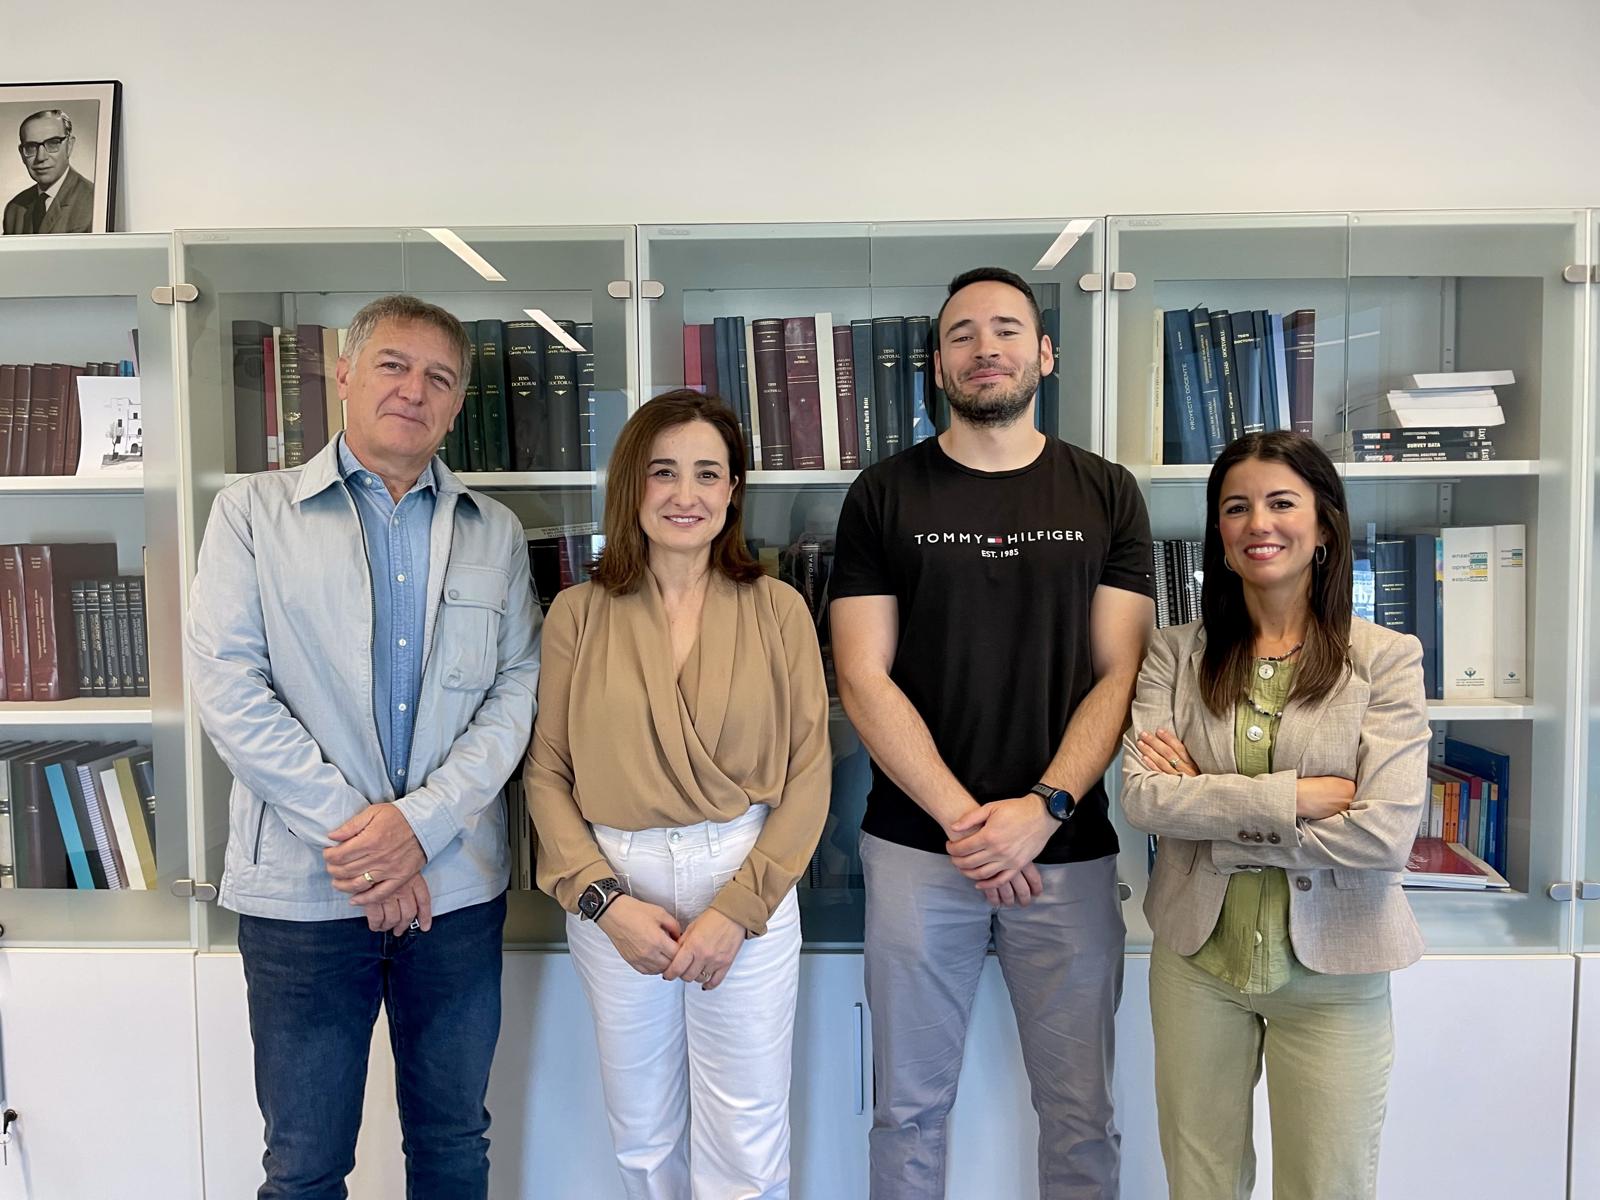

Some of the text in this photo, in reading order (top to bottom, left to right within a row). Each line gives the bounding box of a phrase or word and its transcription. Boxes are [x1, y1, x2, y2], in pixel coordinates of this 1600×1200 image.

[1182, 363, 1196, 431] PROYECTO DOCENTE
[914, 530, 1084, 545] TOMMY HILFIGER
[981, 548, 1019, 559] EST. 1985
